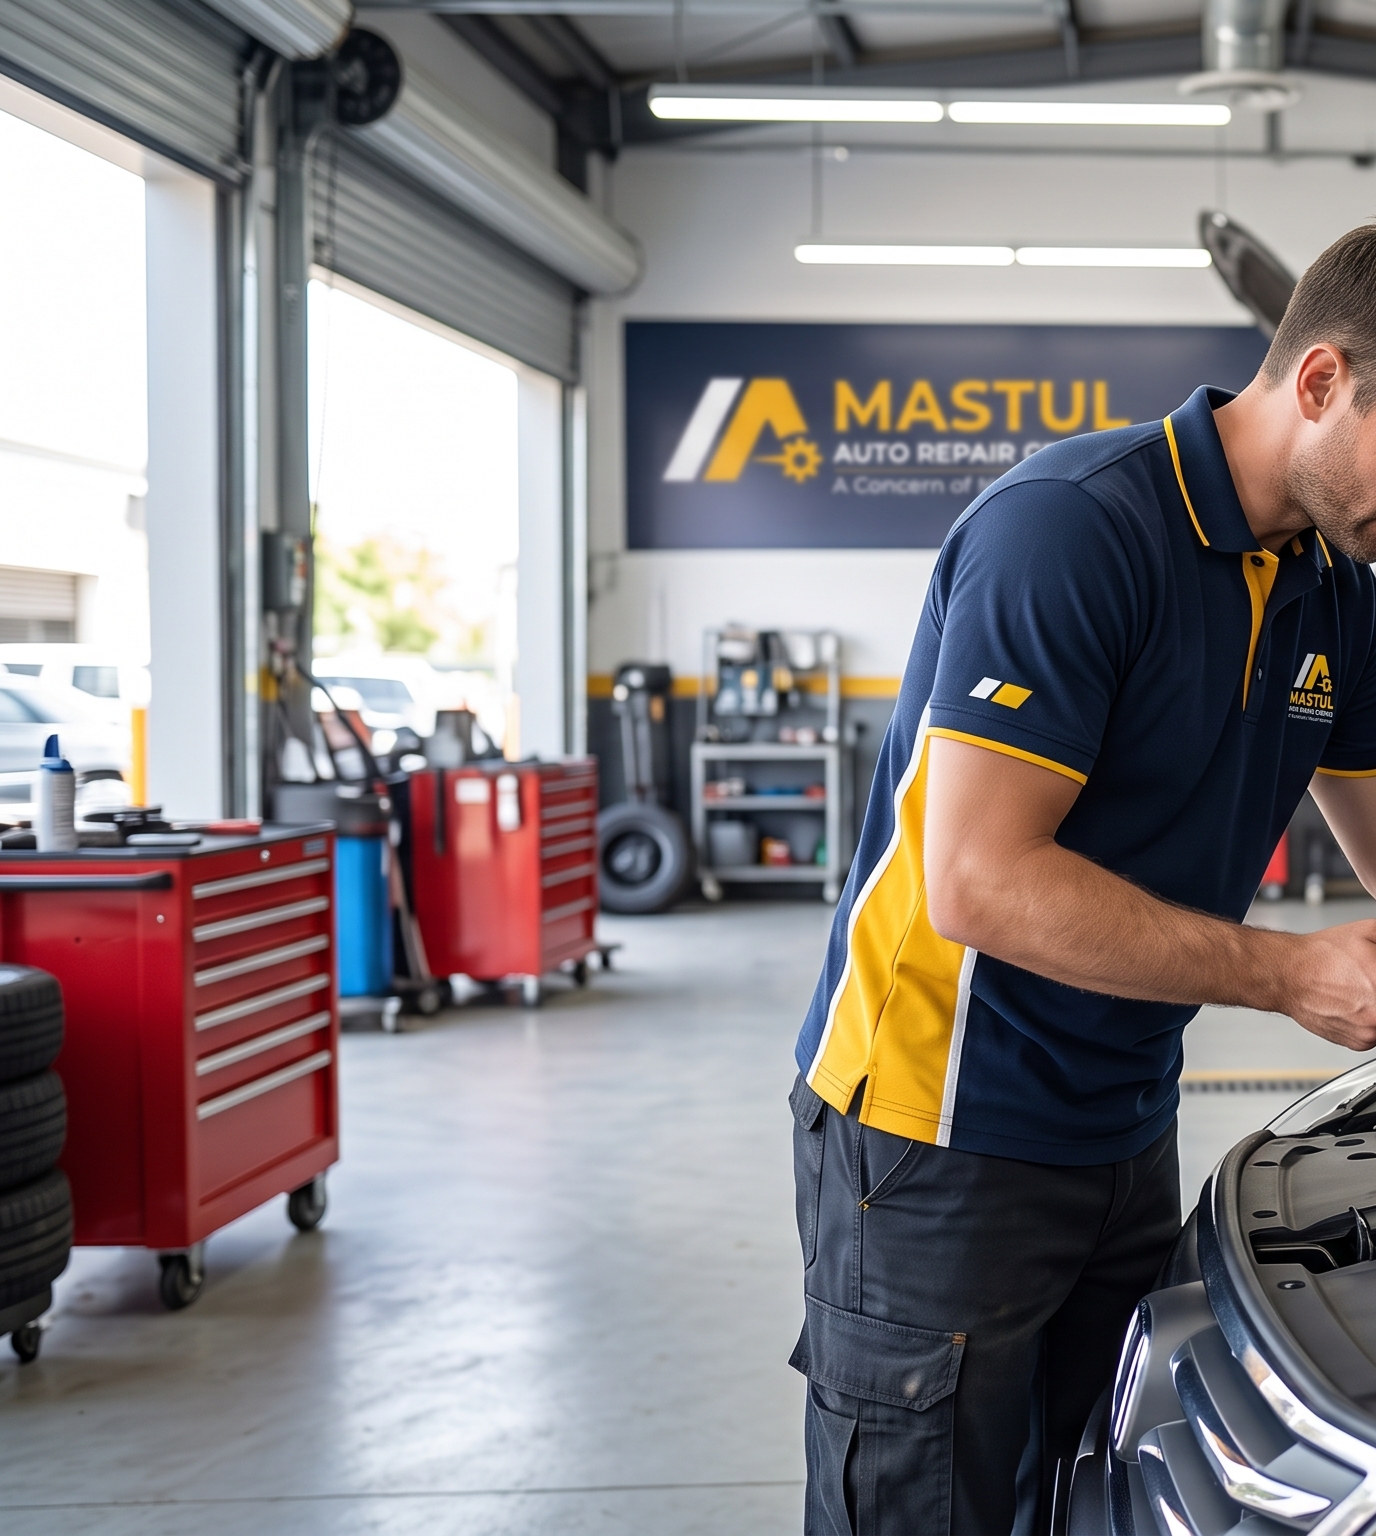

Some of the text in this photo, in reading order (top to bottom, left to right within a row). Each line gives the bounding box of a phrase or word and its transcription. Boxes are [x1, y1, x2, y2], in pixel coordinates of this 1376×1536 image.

[833, 380, 1130, 432] MASTUL
[833, 442, 909, 464] AUTO
[917, 442, 1016, 464] REPAIR
[832, 477, 848, 494] A
[853, 477, 945, 495] Concern
[950, 476, 973, 495] of
[1289, 691, 1334, 709] MASTUL
